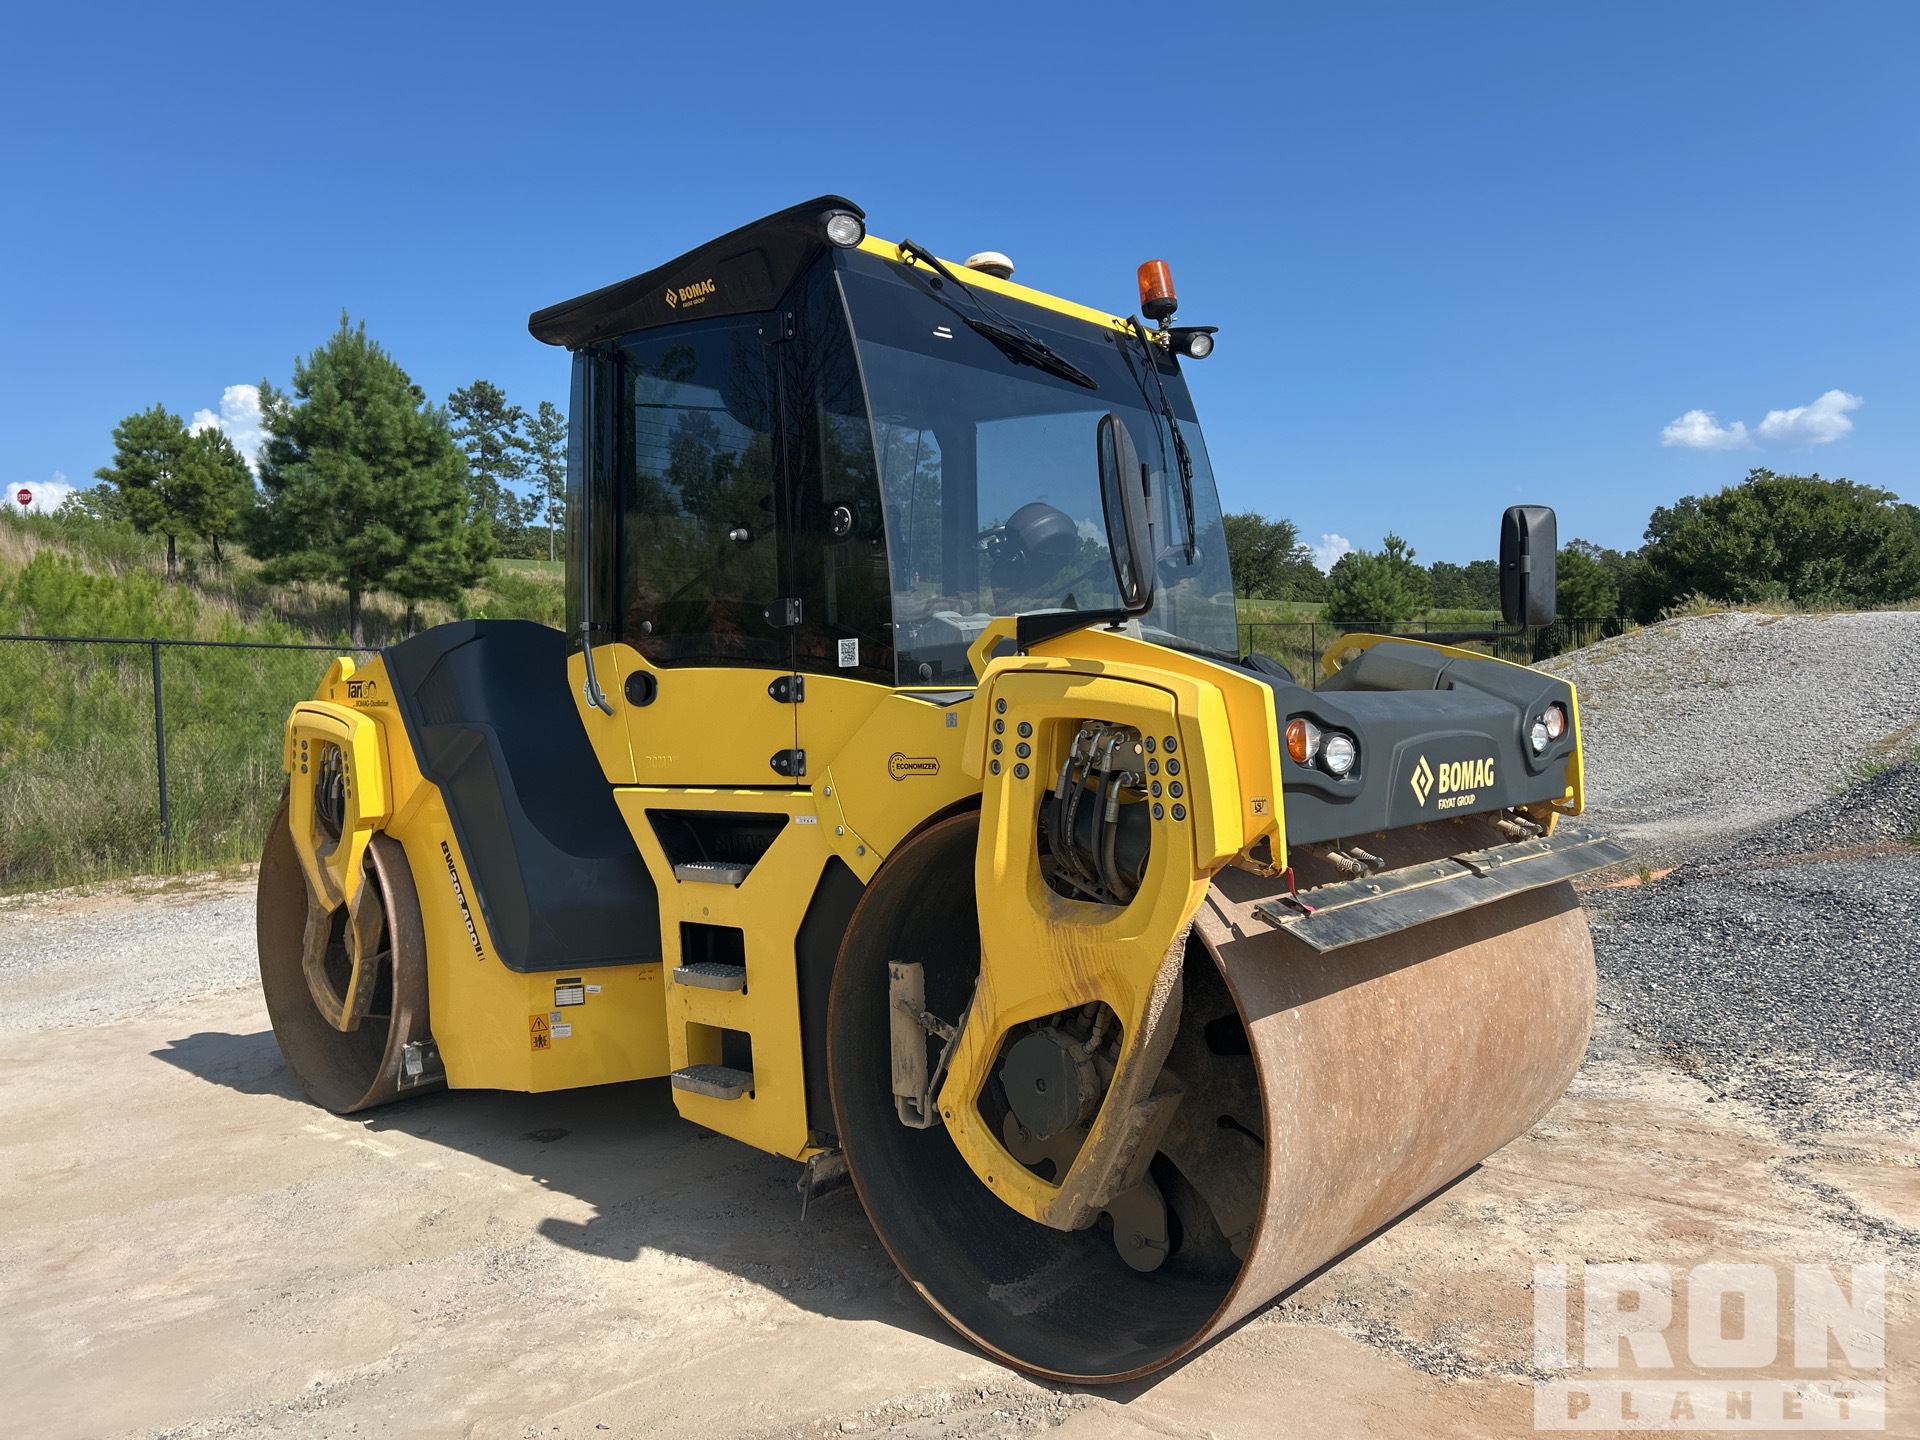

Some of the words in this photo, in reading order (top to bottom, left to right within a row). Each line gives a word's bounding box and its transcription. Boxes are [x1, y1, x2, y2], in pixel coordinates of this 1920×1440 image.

[678, 278, 716, 302] BOMAG
[18, 493, 31, 501] STOP
[1438, 757, 1495, 794] BOMAG
[1438, 797, 1456, 810] FAYAT
[1457, 794, 1476, 807] GROUP
